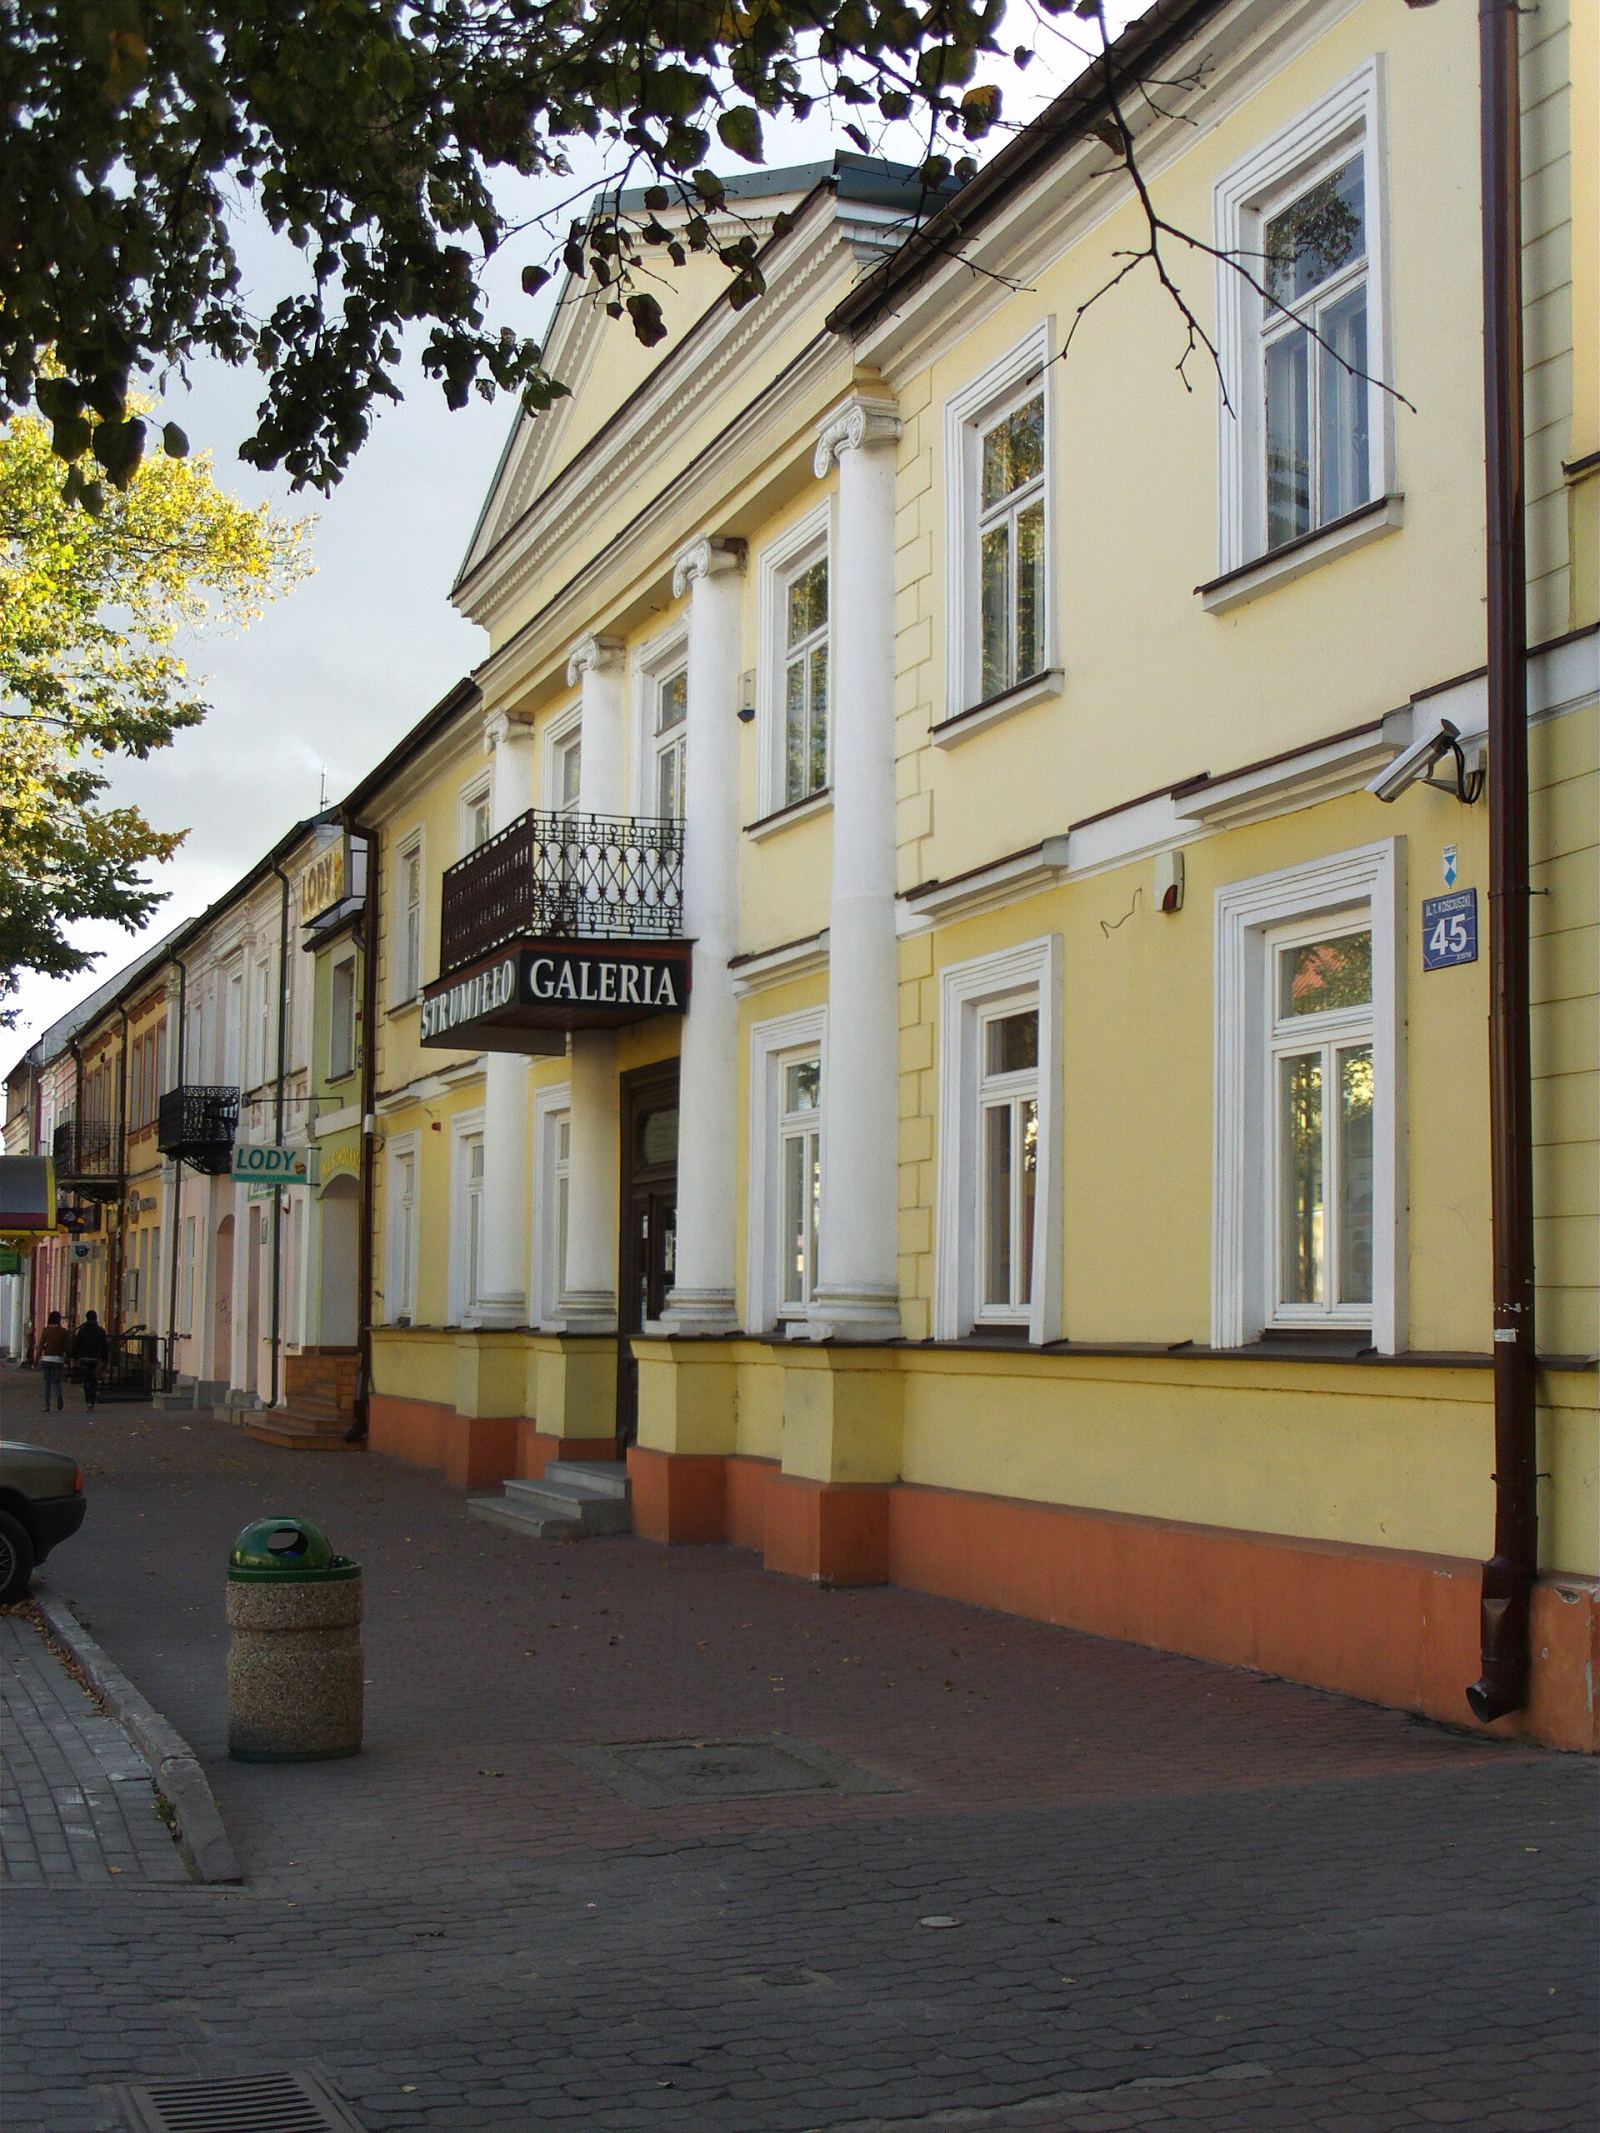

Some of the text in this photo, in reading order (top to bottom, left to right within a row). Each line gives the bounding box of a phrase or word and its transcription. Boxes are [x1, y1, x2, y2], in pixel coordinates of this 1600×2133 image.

[1429, 913, 1467, 956] 45
[530, 958, 678, 1007] GALERIA
[236, 1148, 296, 1171] LODY
